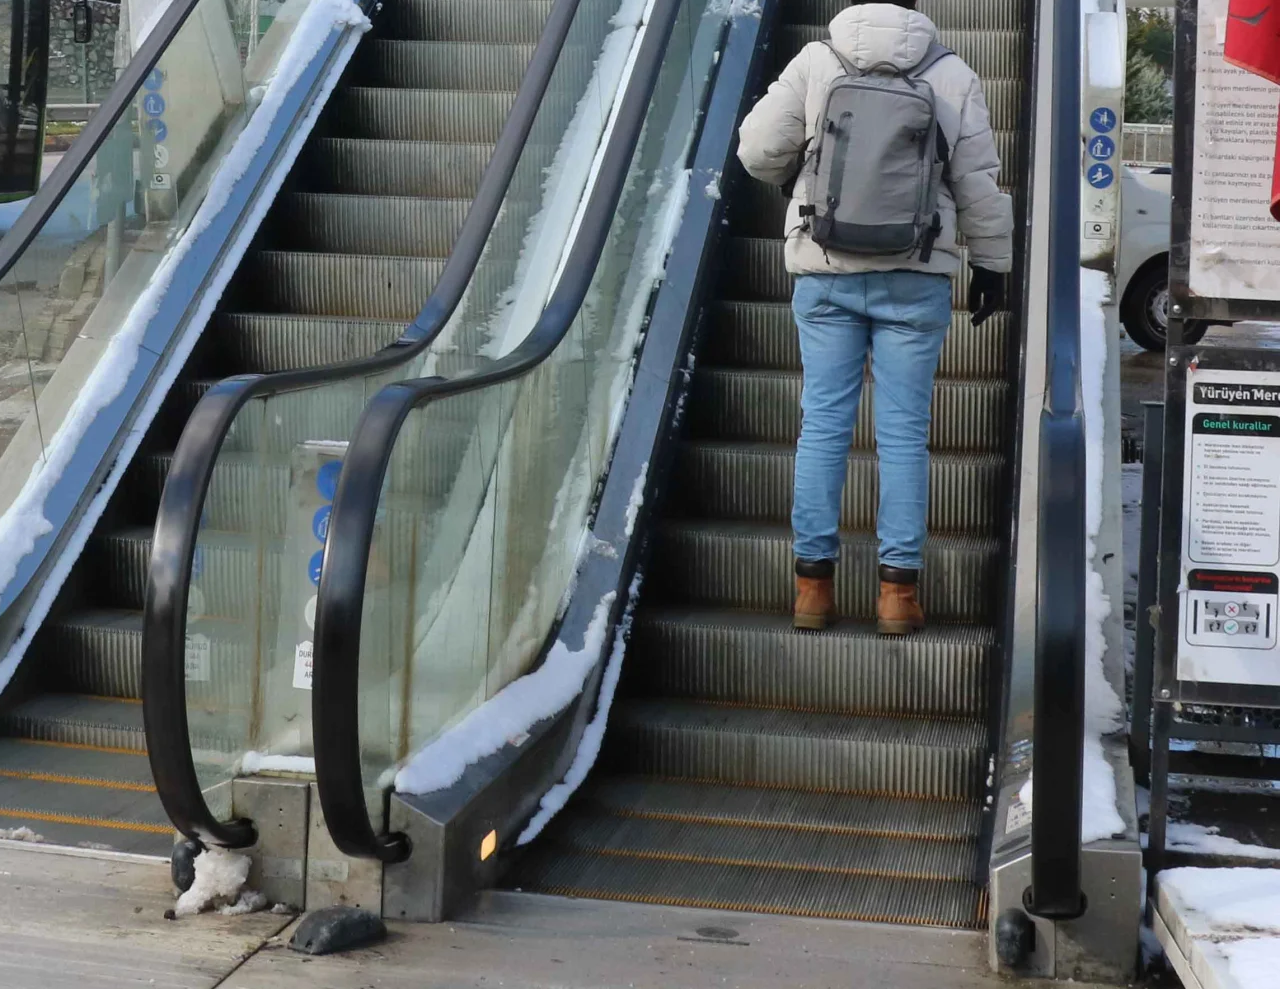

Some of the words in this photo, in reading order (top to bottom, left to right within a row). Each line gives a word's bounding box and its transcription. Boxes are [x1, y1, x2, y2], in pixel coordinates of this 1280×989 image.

[1200, 386, 1250, 402] Yürüyen
[1203, 419, 1230, 429] Genel
[1232, 420, 1272, 431] kurallar
